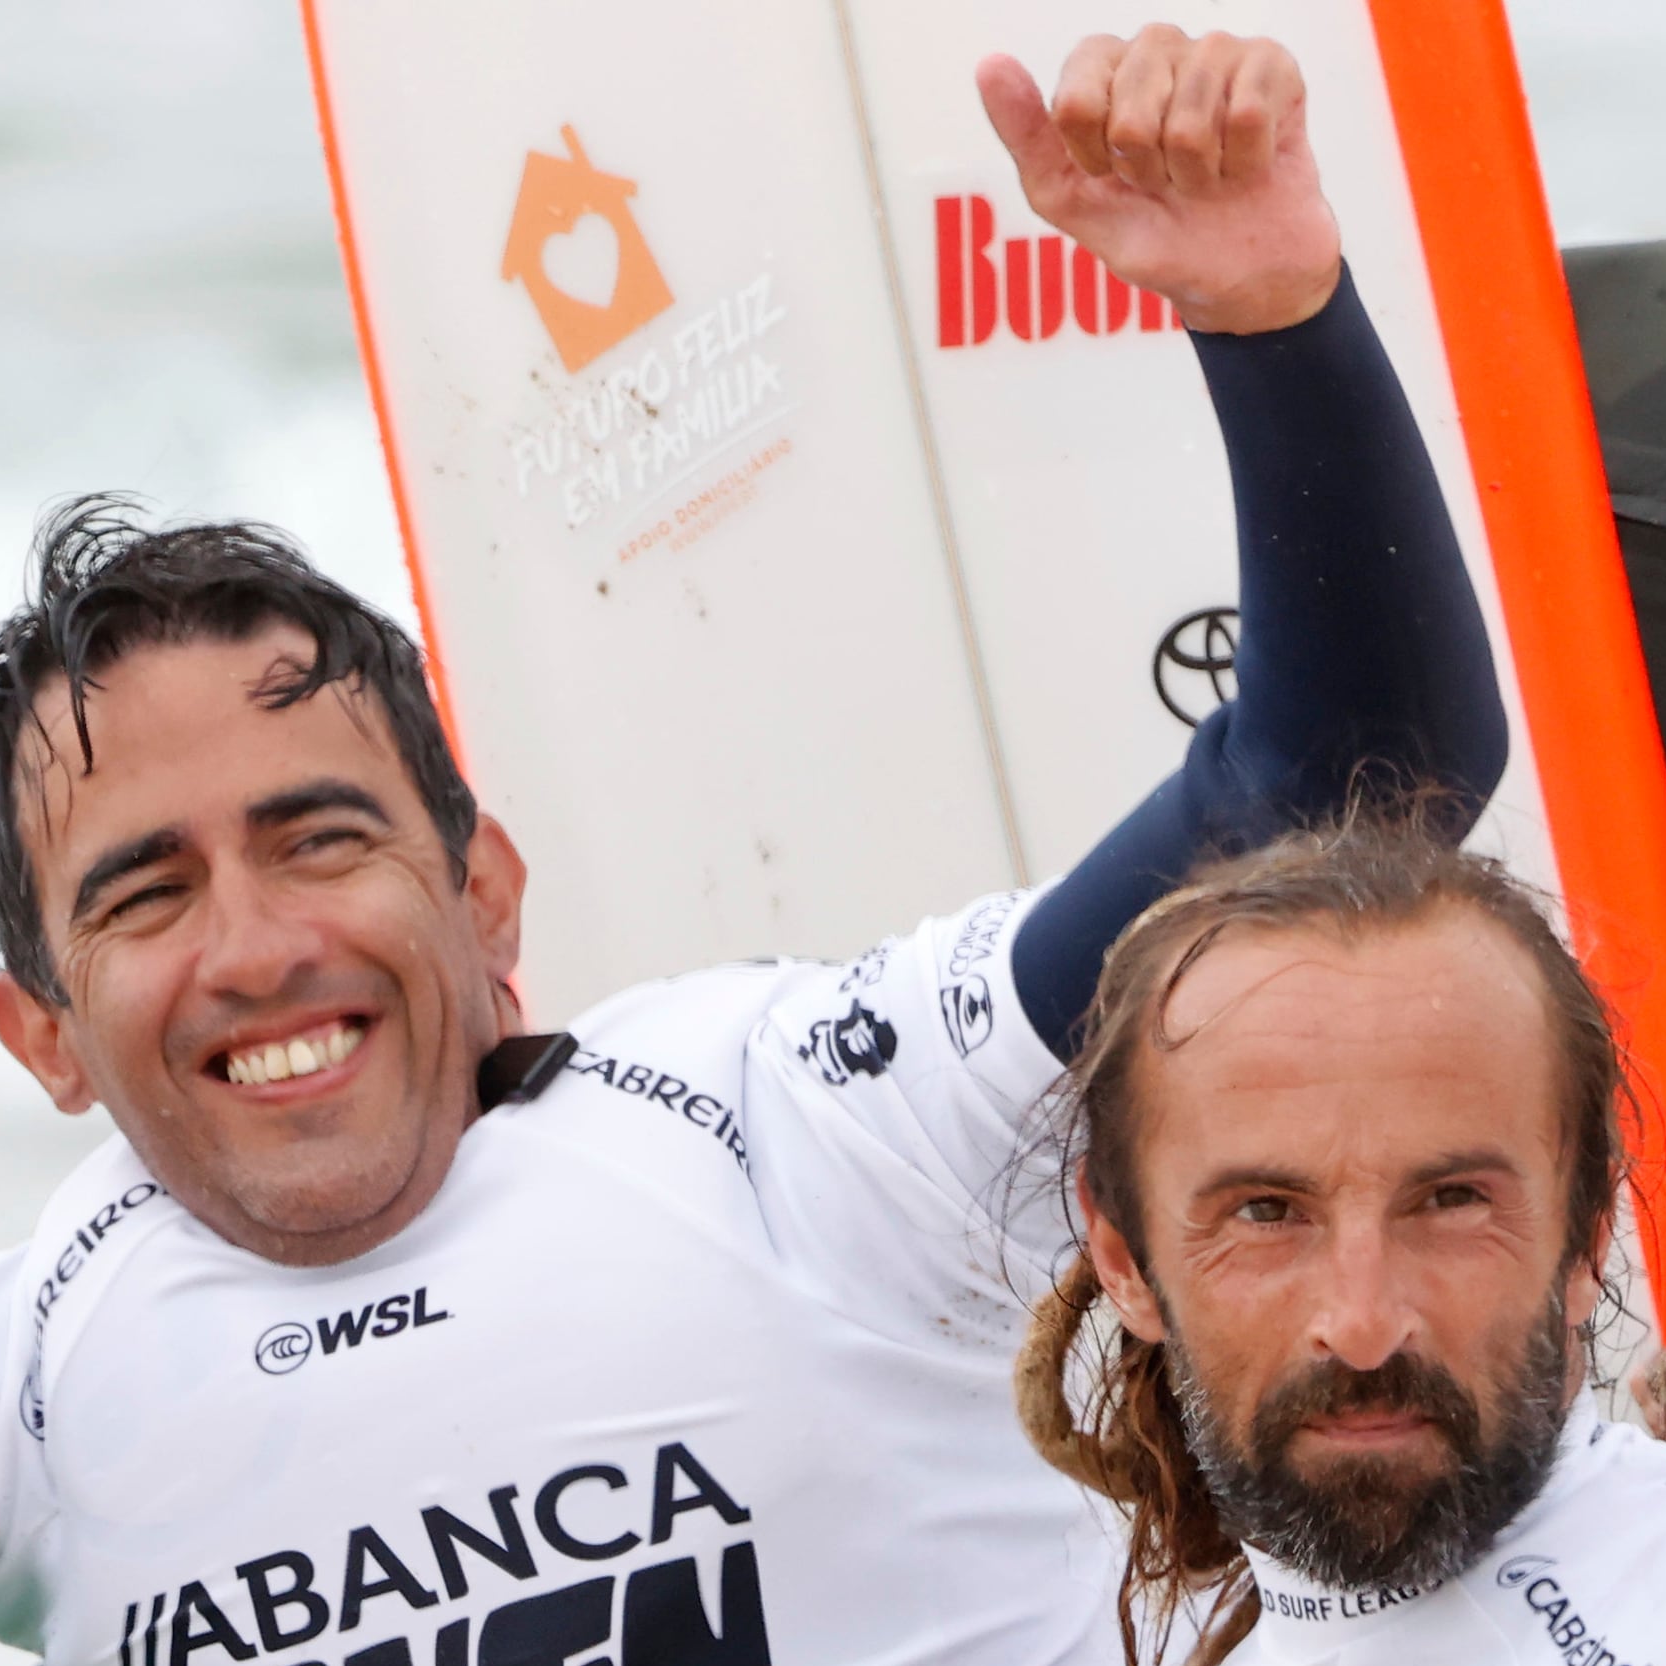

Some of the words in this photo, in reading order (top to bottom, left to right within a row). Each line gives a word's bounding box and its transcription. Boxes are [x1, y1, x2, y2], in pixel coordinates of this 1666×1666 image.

[512, 349, 671, 498] FUTURO
[673, 272, 788, 388] FELIZ
[563, 452, 622, 527] EM
[316, 1286, 449, 1356] WSL
[1279, 1592, 1333, 1622] SURF
